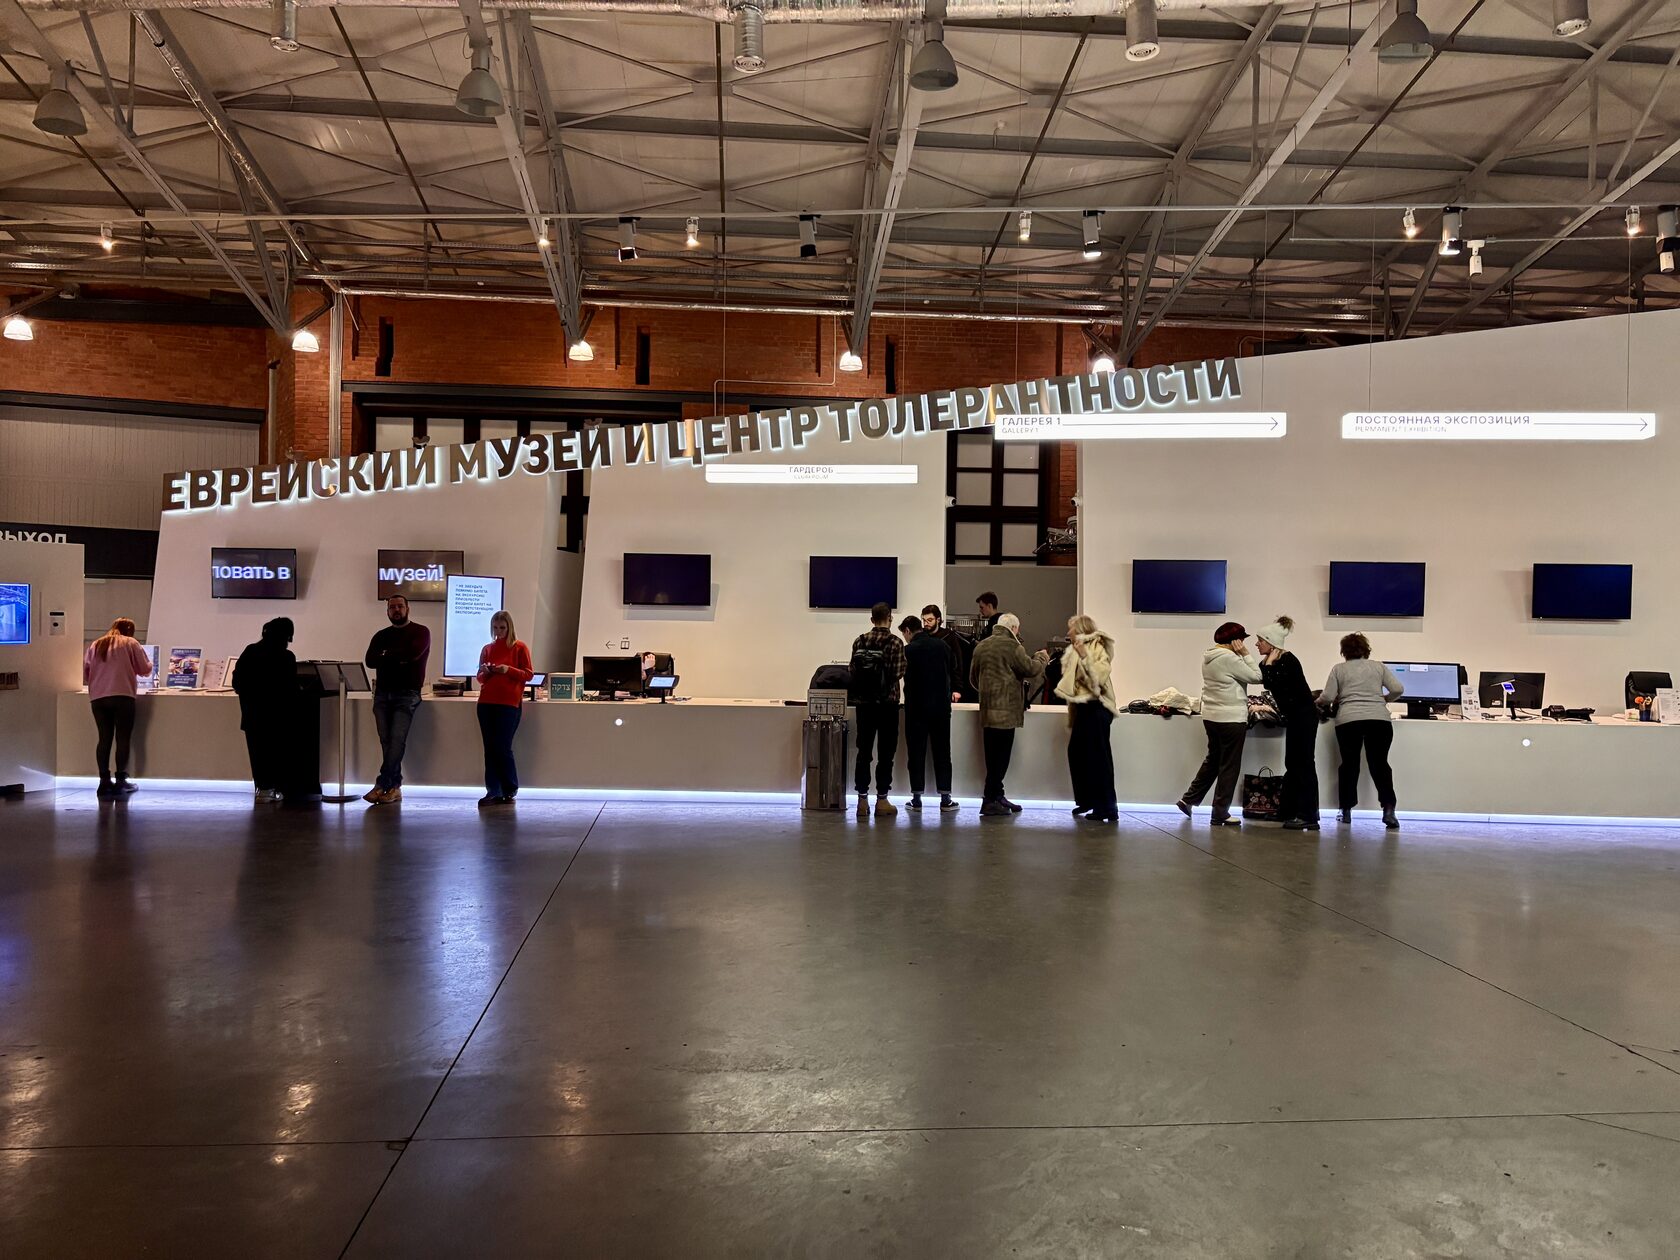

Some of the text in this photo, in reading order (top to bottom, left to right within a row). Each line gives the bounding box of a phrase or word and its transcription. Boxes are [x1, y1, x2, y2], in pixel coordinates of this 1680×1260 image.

[1002, 417, 1061, 425] ГАЛЕРЕЯ 1
[1355, 415, 1530, 425] ПОСТОЯННАЯ ЭКСПОЗИЦИЯ
[161, 356, 1242, 511] ЕВРЕЙСКИЙ МУЗЕЙ И ЦЕНТР ТОЛЕРАНТНОСТИ
[789, 466, 834, 474] ГАРДЕРОБ
[277, 566, 291, 579] в
[379, 564, 444, 585] музей!
